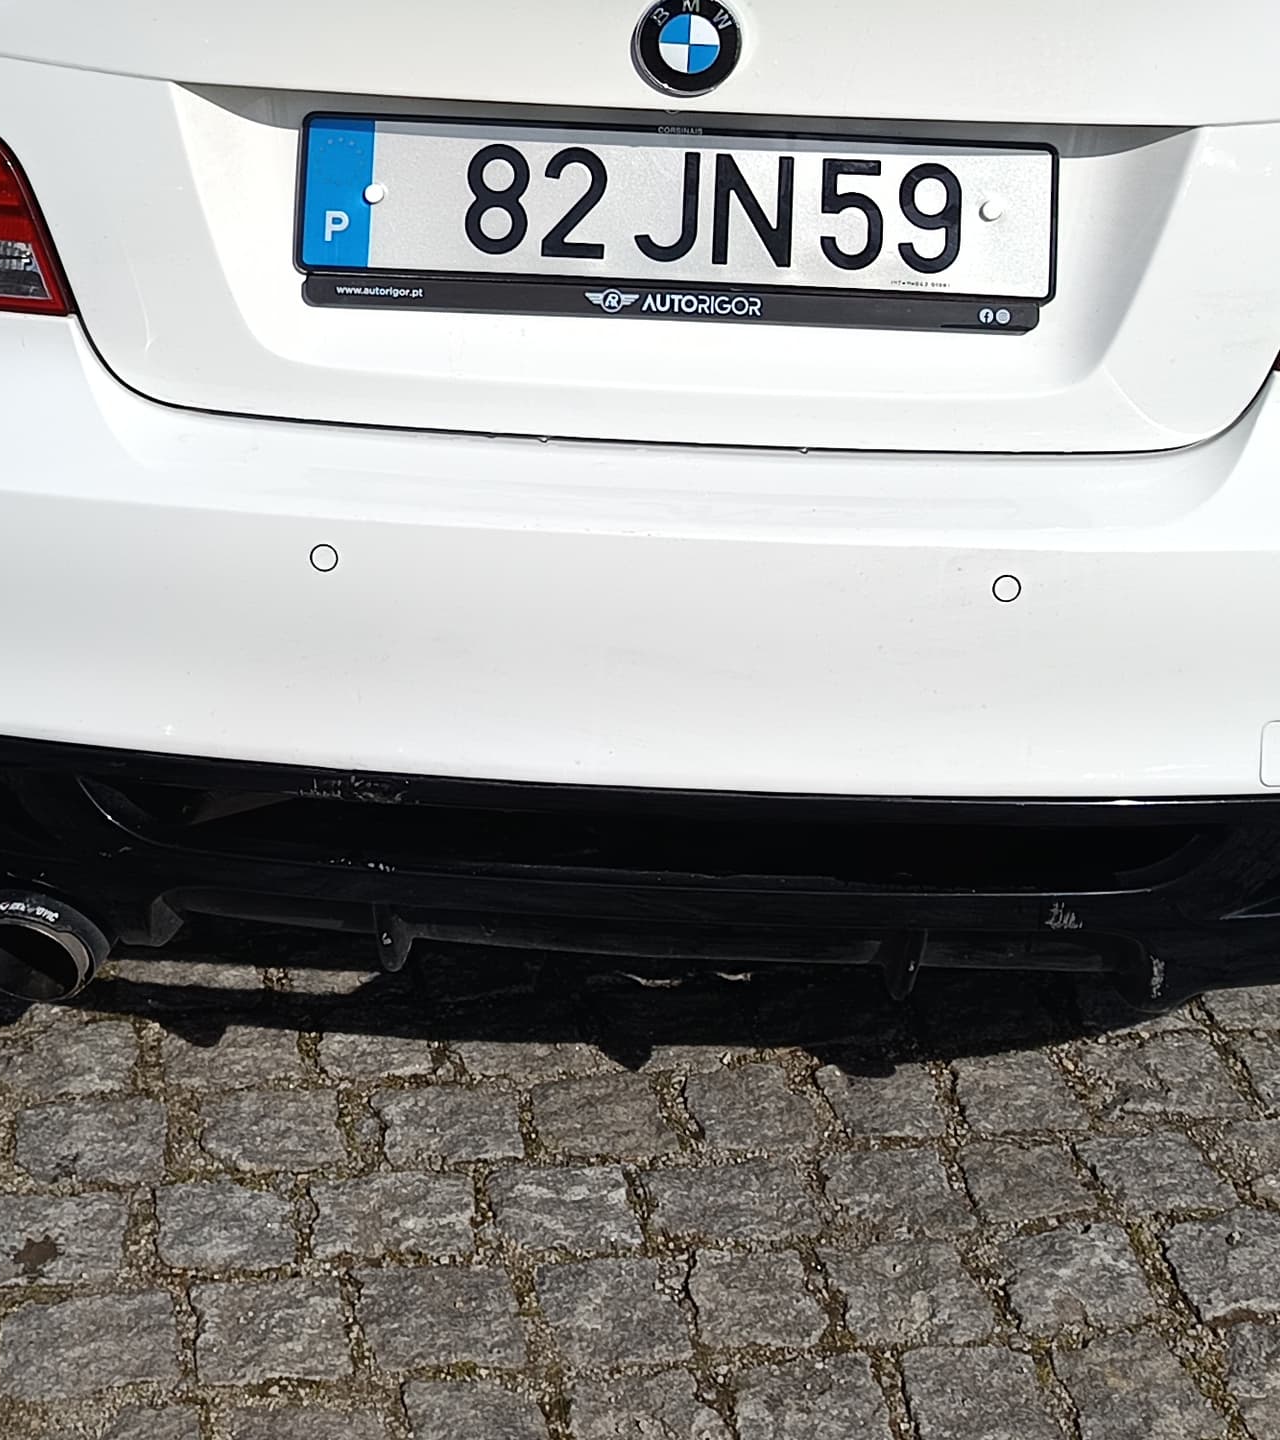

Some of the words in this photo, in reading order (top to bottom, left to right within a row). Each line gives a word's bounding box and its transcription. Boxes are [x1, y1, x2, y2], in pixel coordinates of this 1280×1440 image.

[465, 144, 608, 259] 82
[634, 152, 794, 267] JN
[820, 159, 962, 273] 59
[324, 210, 350, 242] P
[336, 286, 424, 298] www.autorigor.pt
[642, 293, 761, 316] AUTORIGOR
